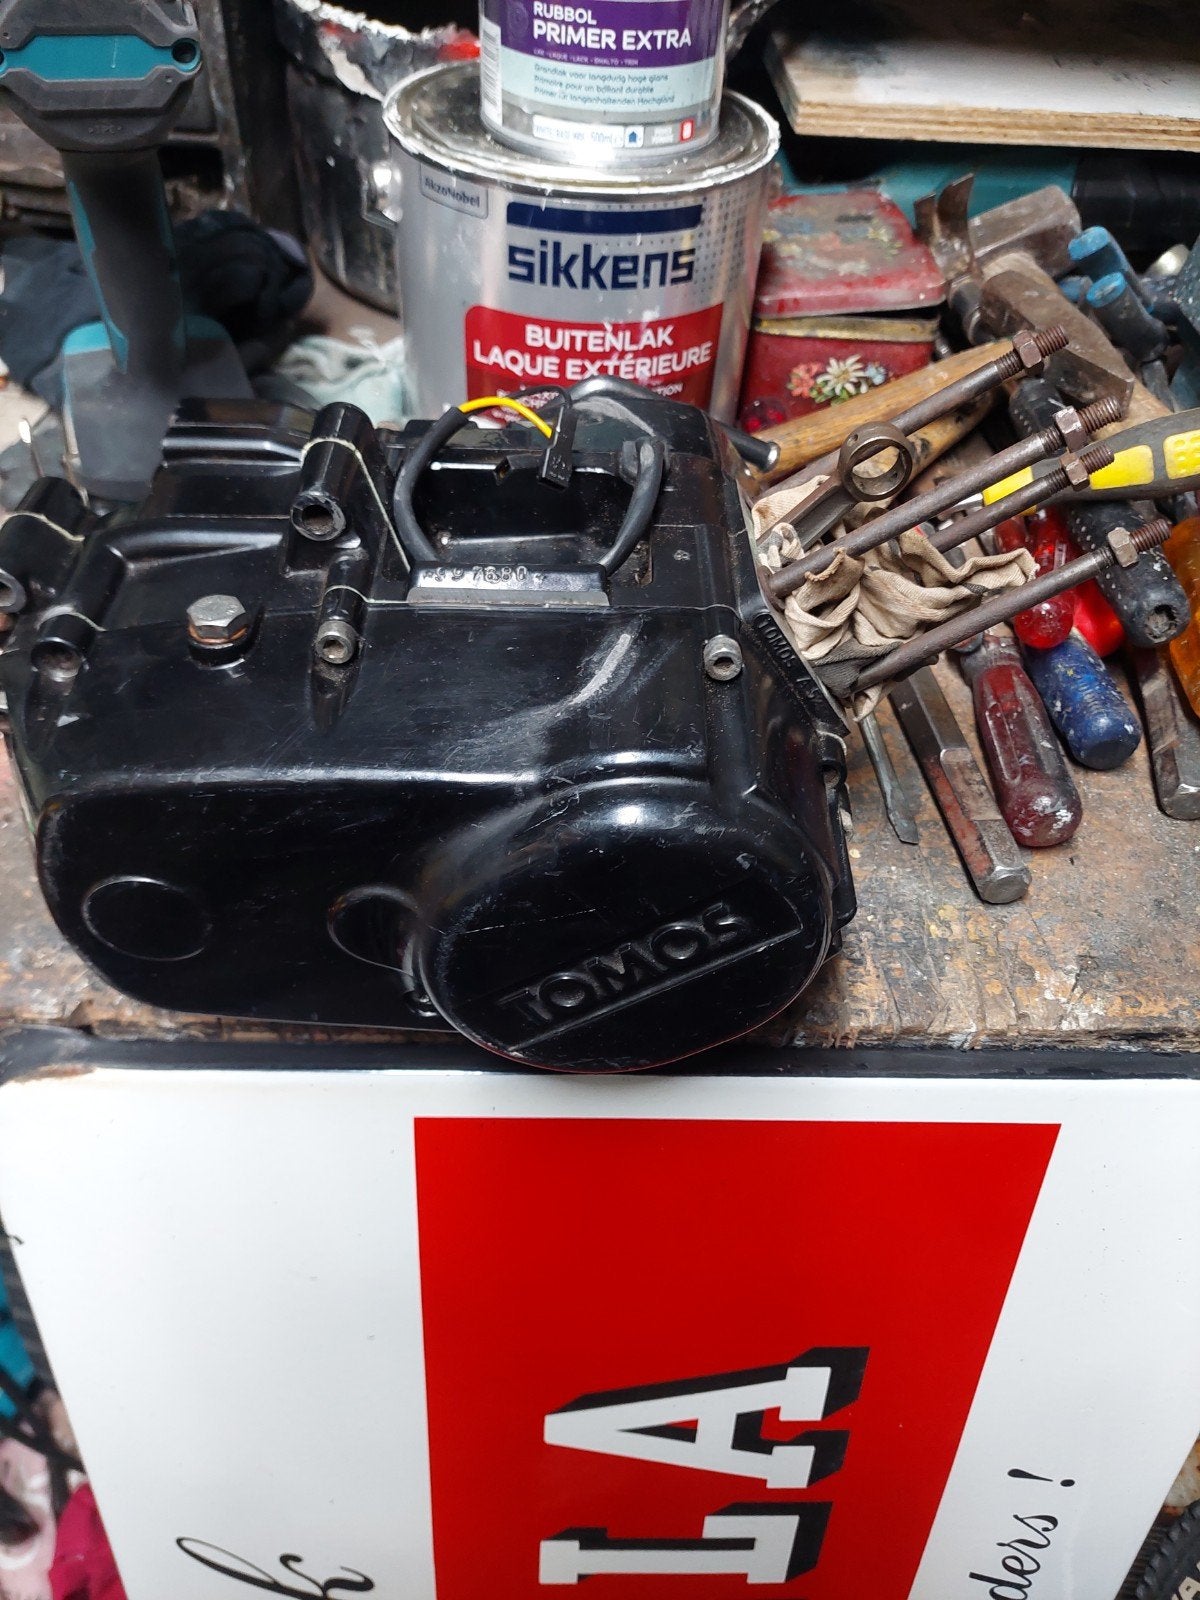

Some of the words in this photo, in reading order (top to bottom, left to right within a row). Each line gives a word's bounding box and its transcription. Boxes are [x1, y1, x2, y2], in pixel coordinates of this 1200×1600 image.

[533, 1, 597, 25] RUBBOL
[533, 19, 617, 50] PRIMER
[622, 28, 692, 50] EXTRA
[424, 177, 480, 208] AkzoNobel
[508, 240, 696, 290] sikkens
[524, 322, 674, 353] BUITENLAK
[473, 340, 560, 379] LAQUE
[565, 341, 713, 381] EXTÉRIEURE
[497, 902, 749, 1024] TOMOS
[538, 1346, 871, 1585] LA
